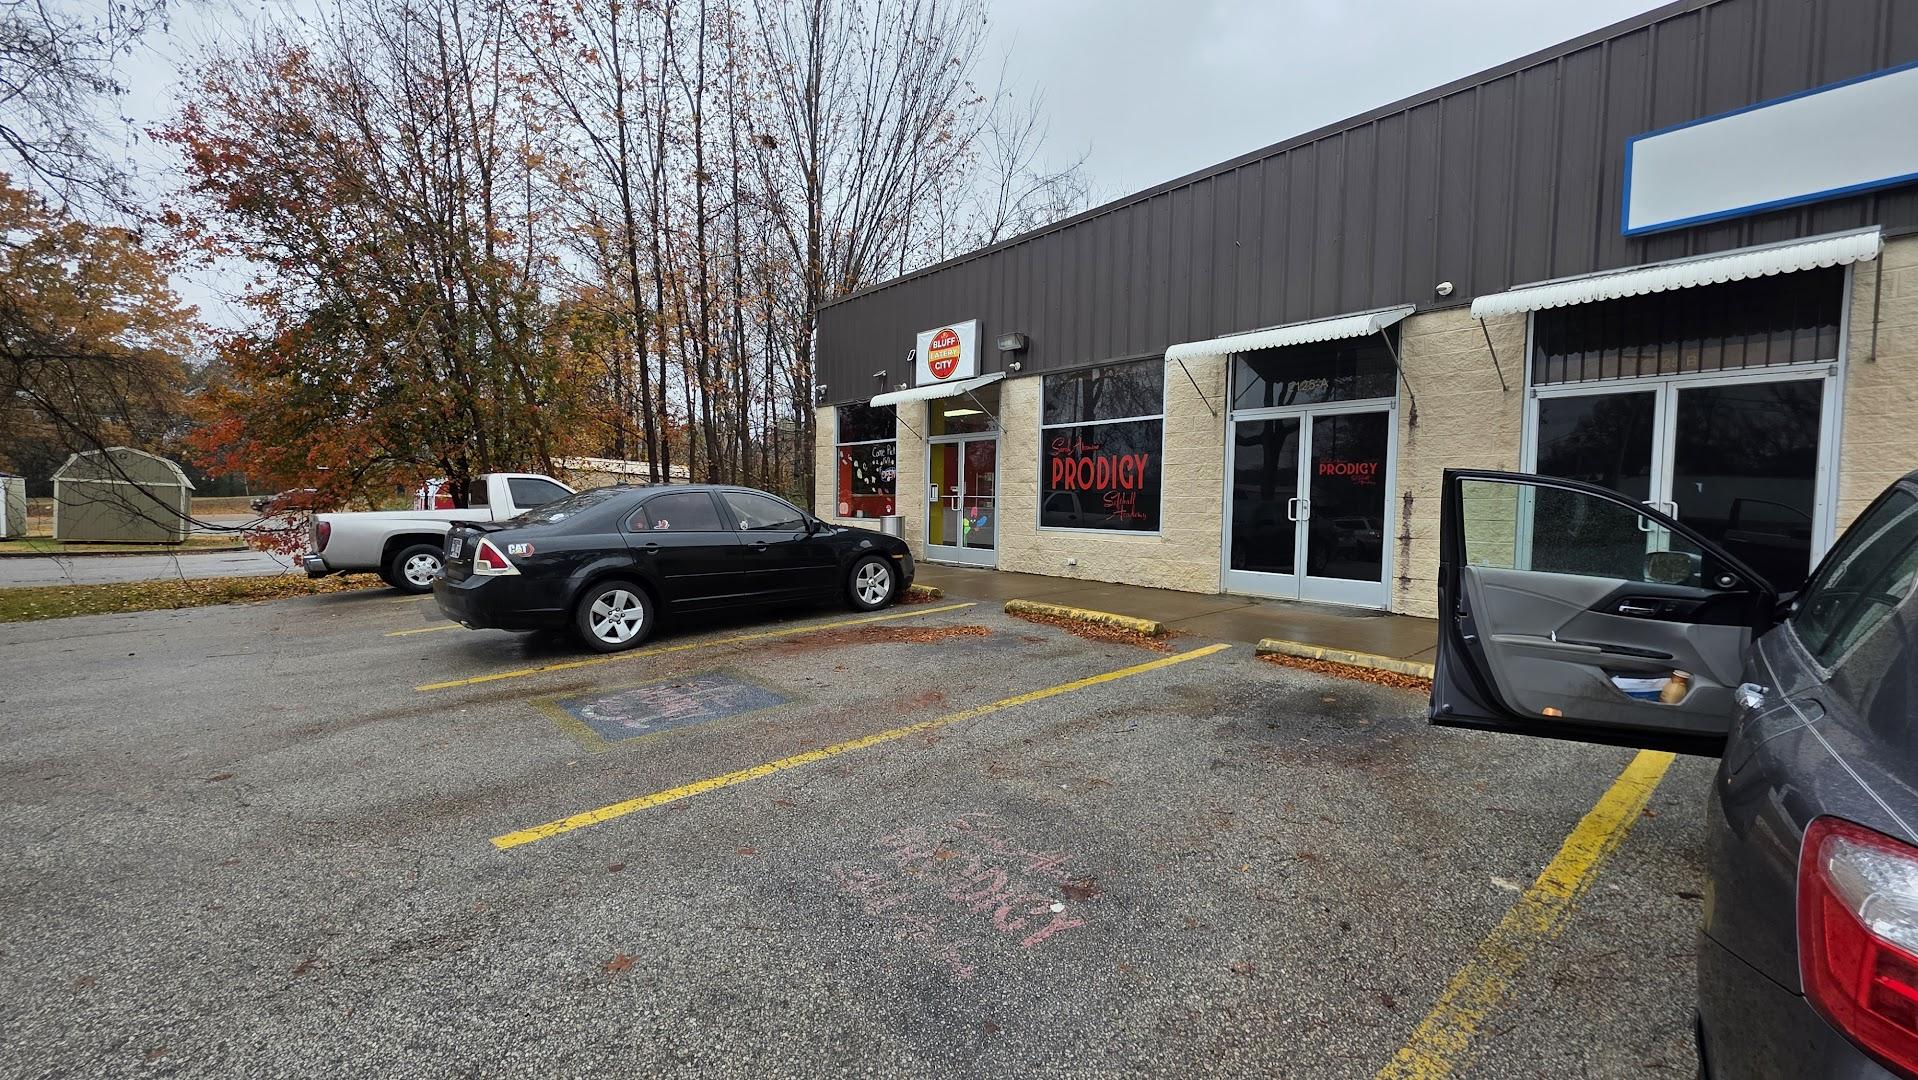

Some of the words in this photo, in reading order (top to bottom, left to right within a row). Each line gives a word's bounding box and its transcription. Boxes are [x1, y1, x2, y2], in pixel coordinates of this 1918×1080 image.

[933, 336, 956, 349] BLUFF
[935, 360, 952, 370] CITY
[1052, 453, 1148, 490] PRODIGY
[1319, 462, 1377, 475] PRODIGY
[508, 543, 528, 555] CAT
